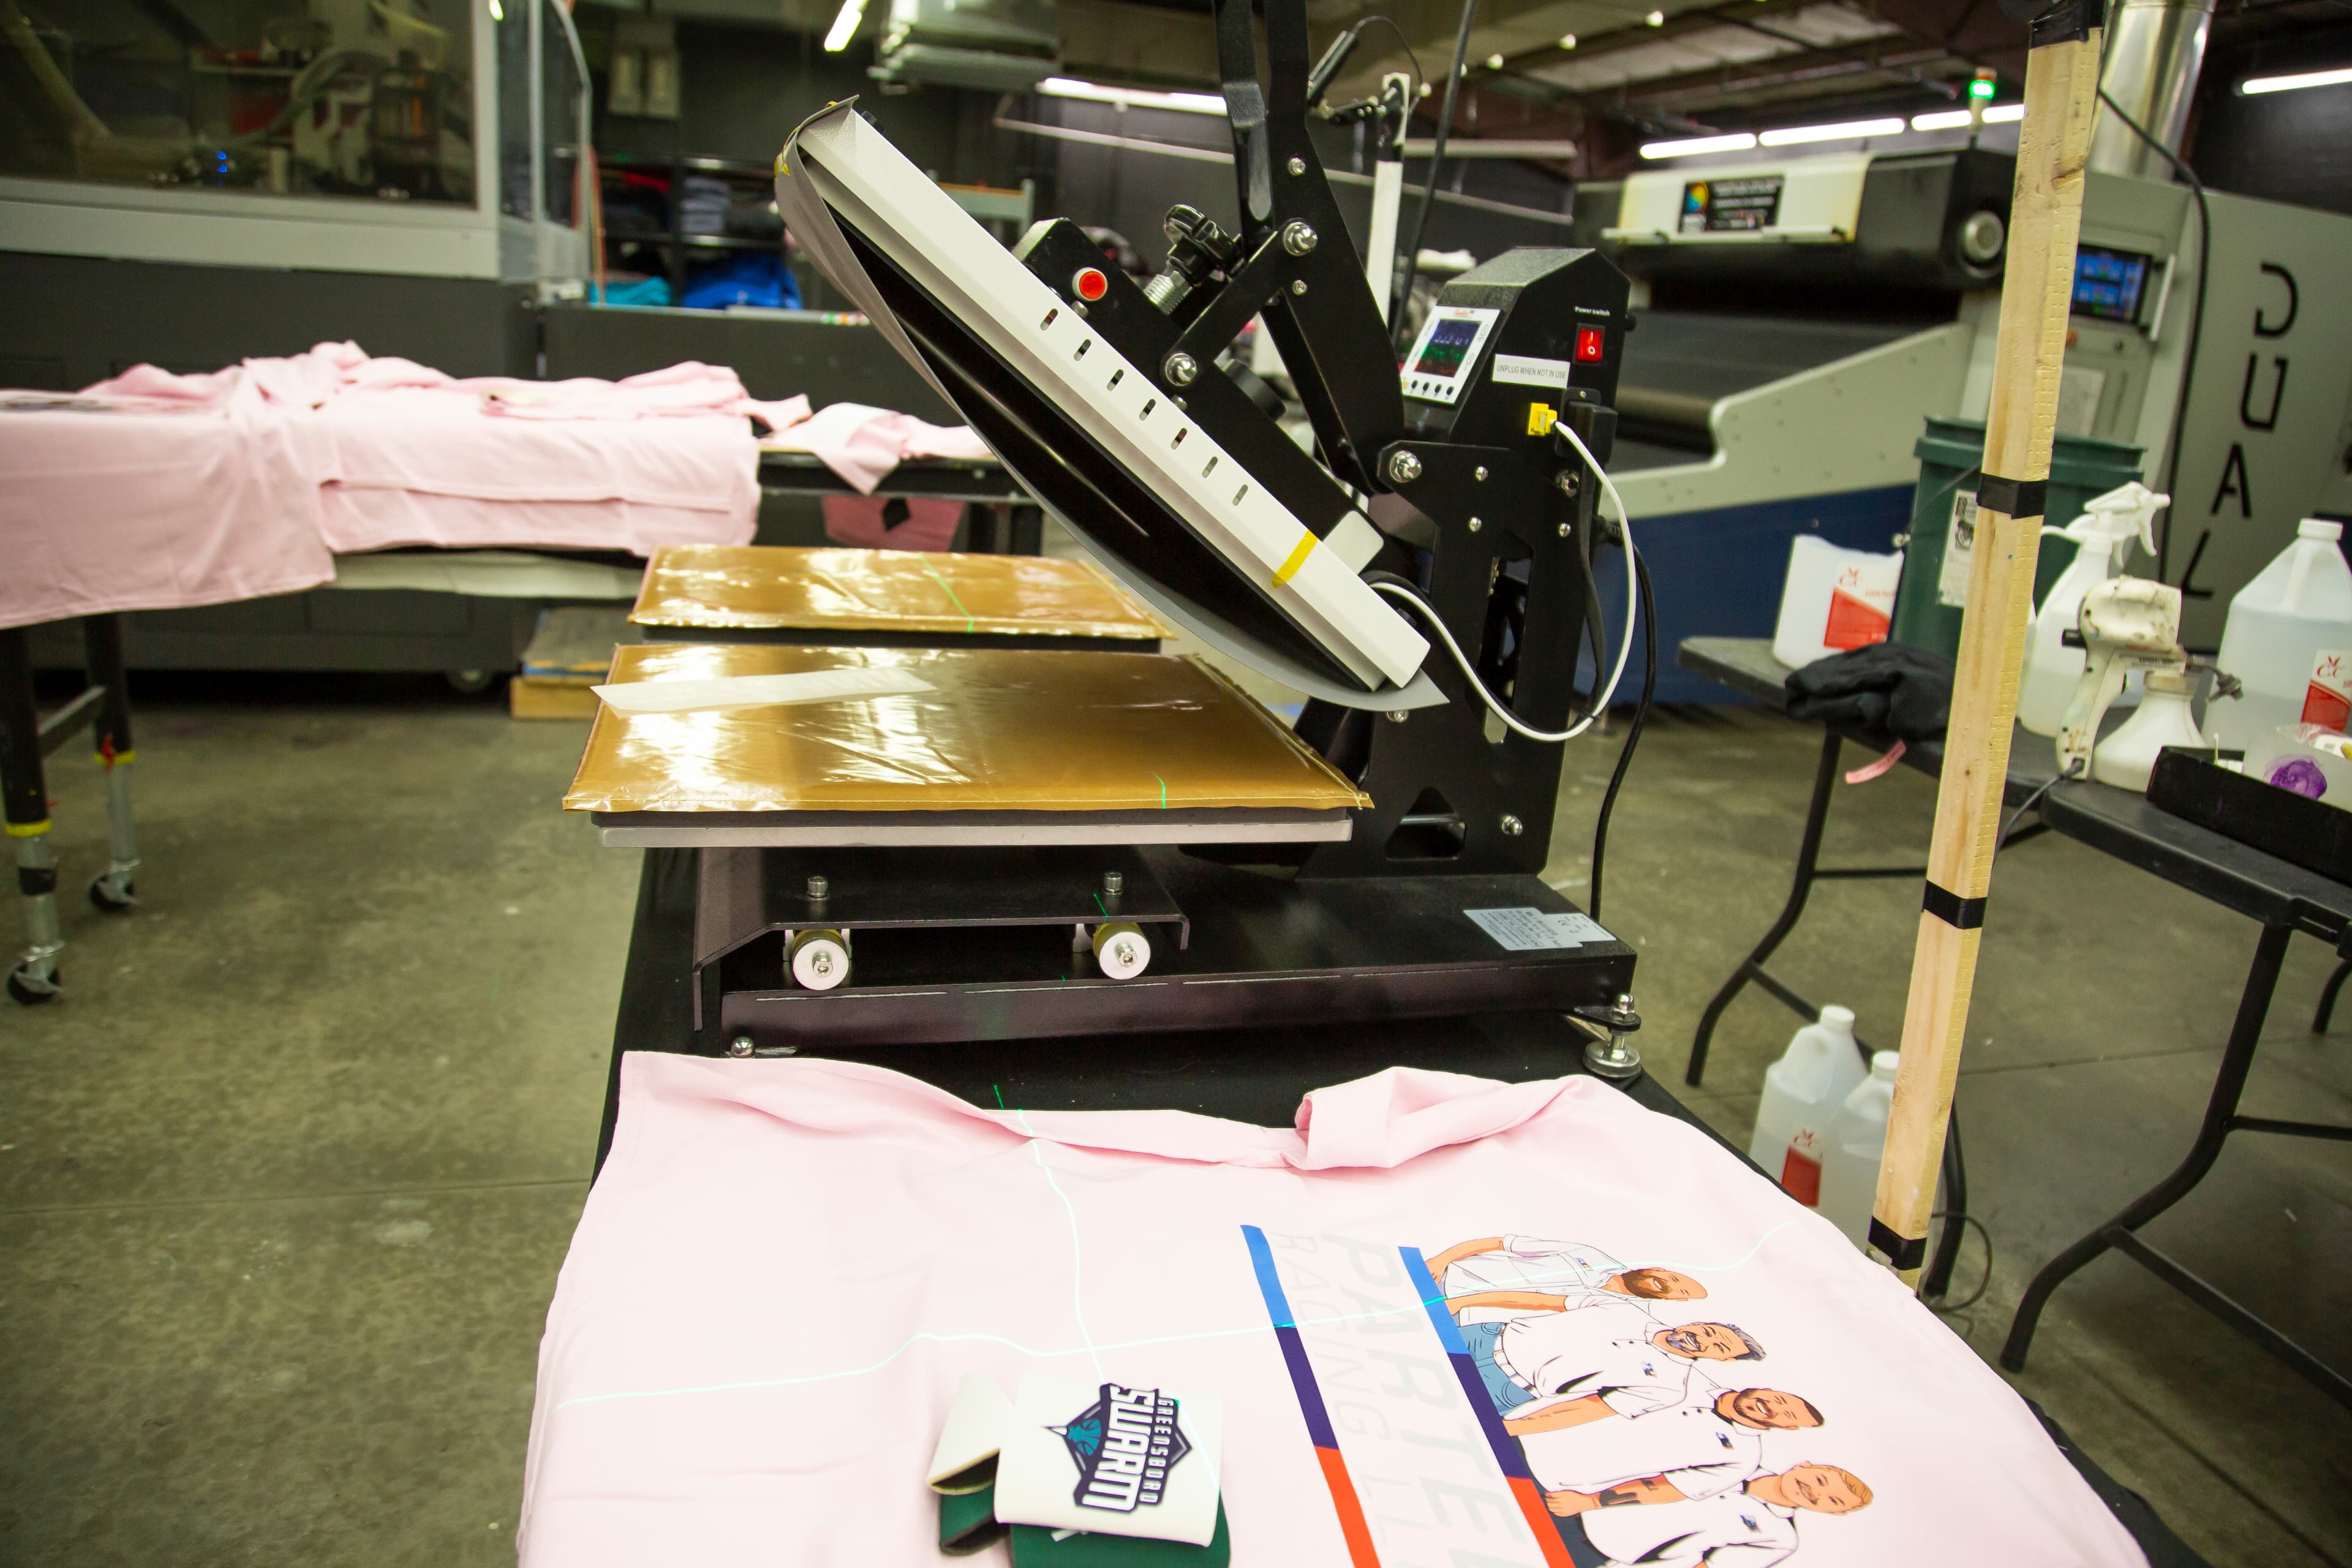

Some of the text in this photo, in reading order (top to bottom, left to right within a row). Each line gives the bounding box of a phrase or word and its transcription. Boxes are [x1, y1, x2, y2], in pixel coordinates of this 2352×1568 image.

[1497, 363, 1520, 374] UNPLUG
[1520, 366, 1536, 375] WHEN
[1537, 368, 1548, 377] NOT
[1271, 1231, 1393, 1441] RACING
[1322, 1231, 1537, 1568] PARTE
[1082, 1385, 1156, 1512] SWARM
[1139, 1397, 1174, 1503] GREENSBORO
